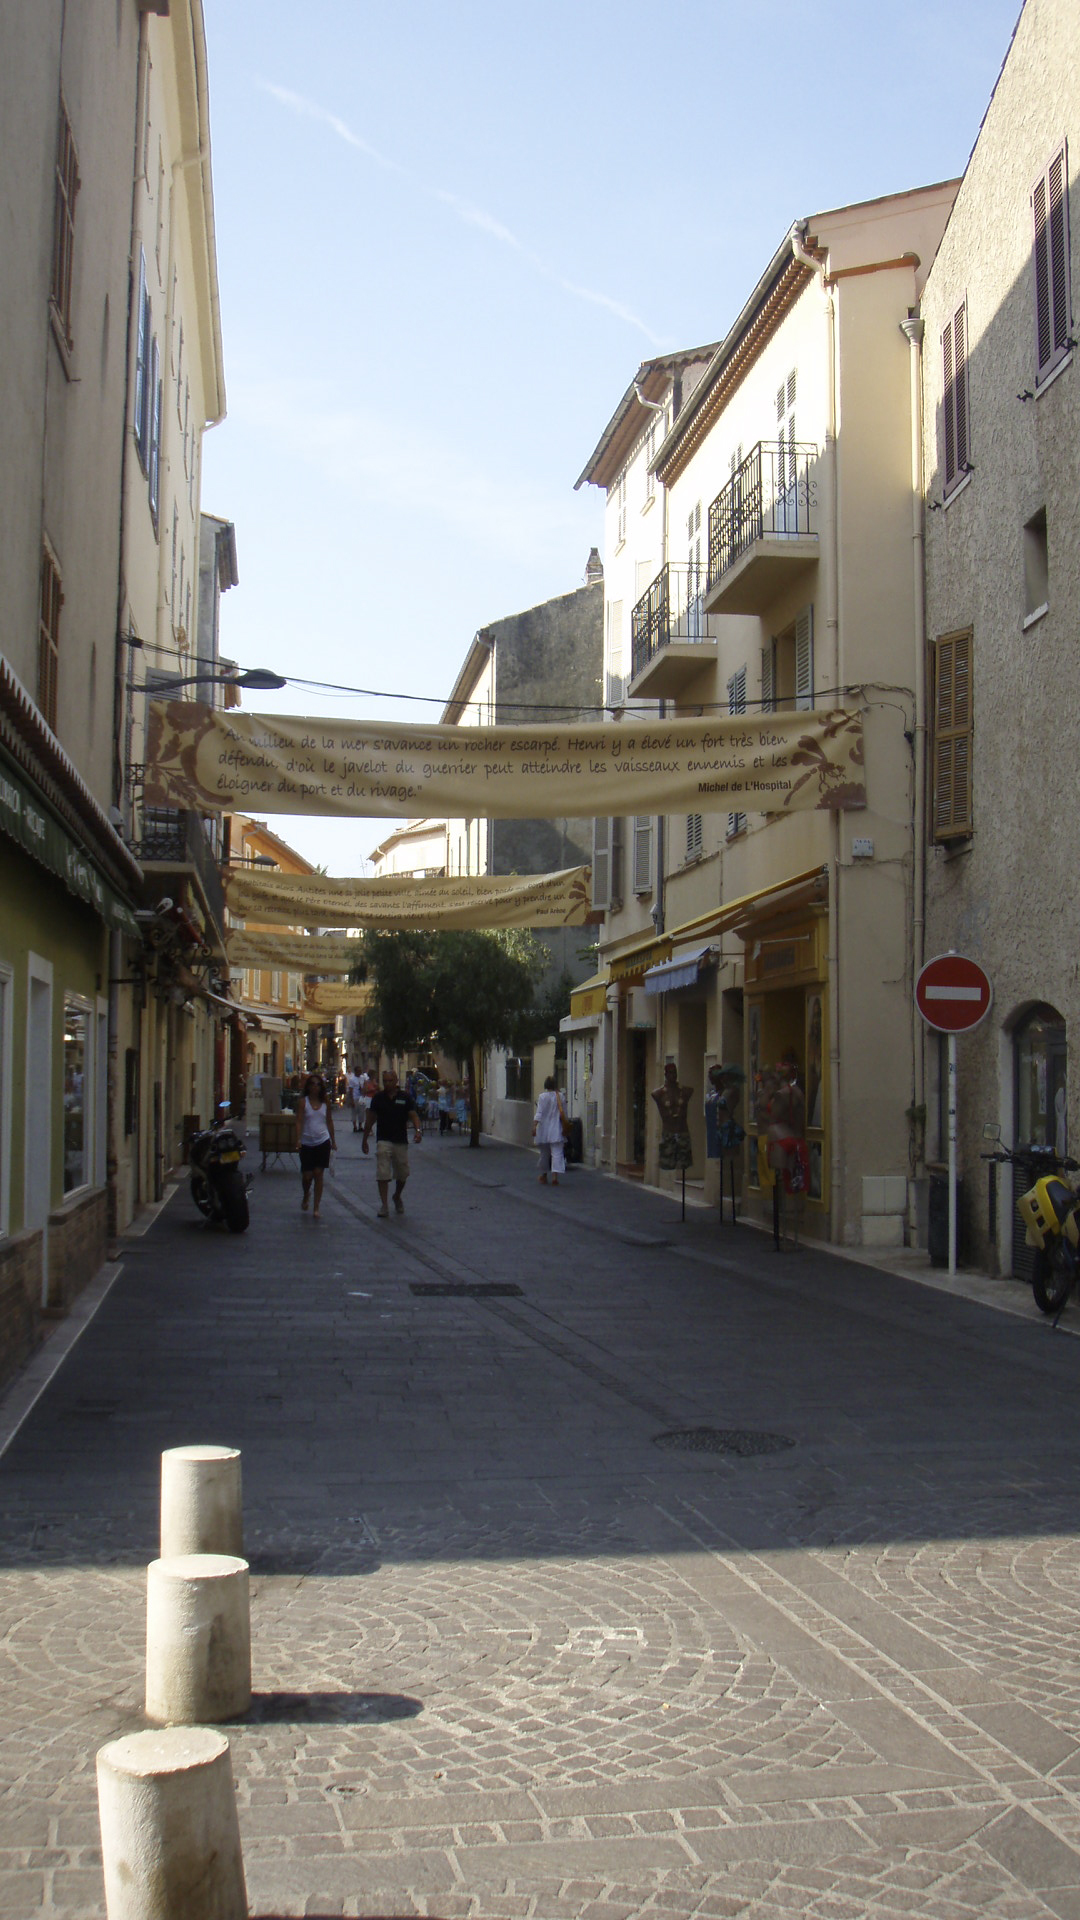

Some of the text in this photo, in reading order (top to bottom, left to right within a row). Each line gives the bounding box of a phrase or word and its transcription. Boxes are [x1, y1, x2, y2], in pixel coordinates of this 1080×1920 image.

[249, 732, 295, 748] milieu
[300, 735, 317, 749] de
[322, 736, 336, 749] la
[341, 740, 369, 751] mer
[373, 738, 432, 751] s'avance
[438, 740, 459, 752] un
[464, 738, 505, 752] rocher
[510, 736, 561, 756] escarpé.
[567, 735, 607, 751] Henri
[611, 738, 622, 757] y
[627, 740, 636, 750] a
[641, 735, 671, 750] élevé
[676, 738, 697, 749] un
[700, 732, 726, 752] fort
[730, 732, 755, 748] très
[759, 730, 789, 746] bien
[218, 750, 789, 780] défendu, d'où le javelot du guerrier peut atteindre les vaisseaux ennemis et les
[217, 774, 424, 802] éloigner du port et du rivage."
[698, 780, 793, 793] Michel de L'Hospital
[438, 887, 450, 896] du
